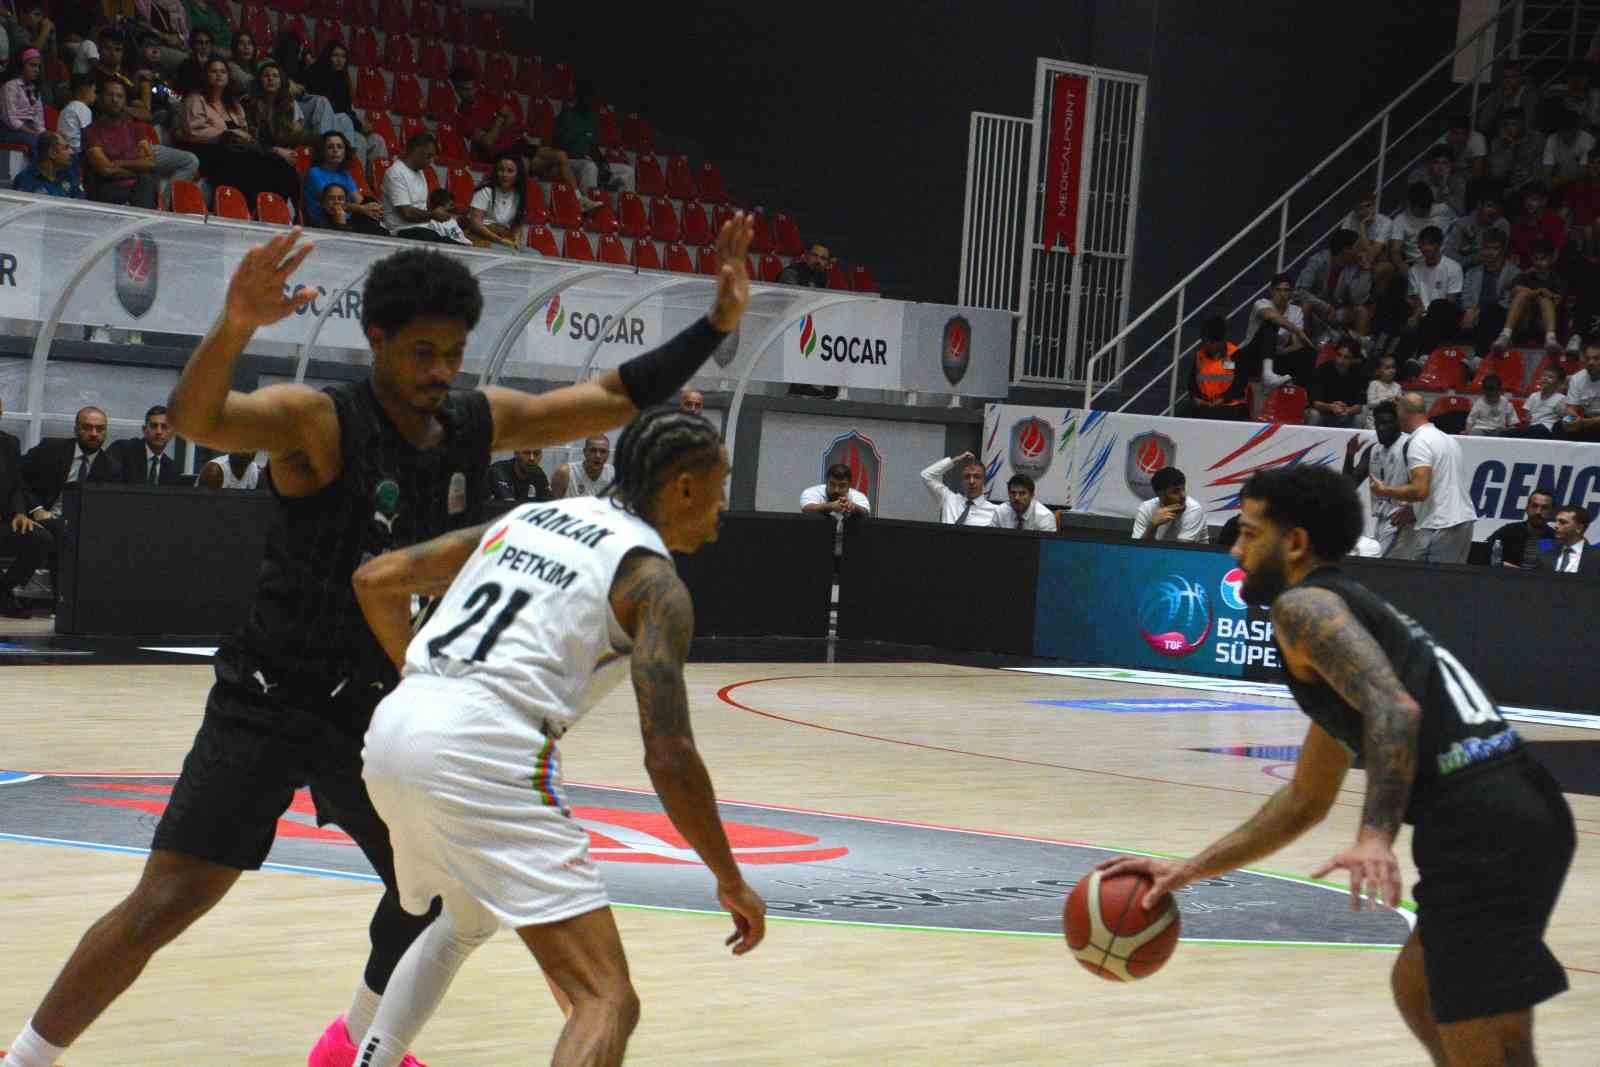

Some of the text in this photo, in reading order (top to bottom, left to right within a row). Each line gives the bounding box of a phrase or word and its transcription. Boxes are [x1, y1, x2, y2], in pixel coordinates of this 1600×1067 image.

[569, 311, 645, 345] SOCAR
[820, 334, 888, 366] SOCAR
[428, 581, 533, 664] 21
[1215, 641, 1283, 669] SÜPE
